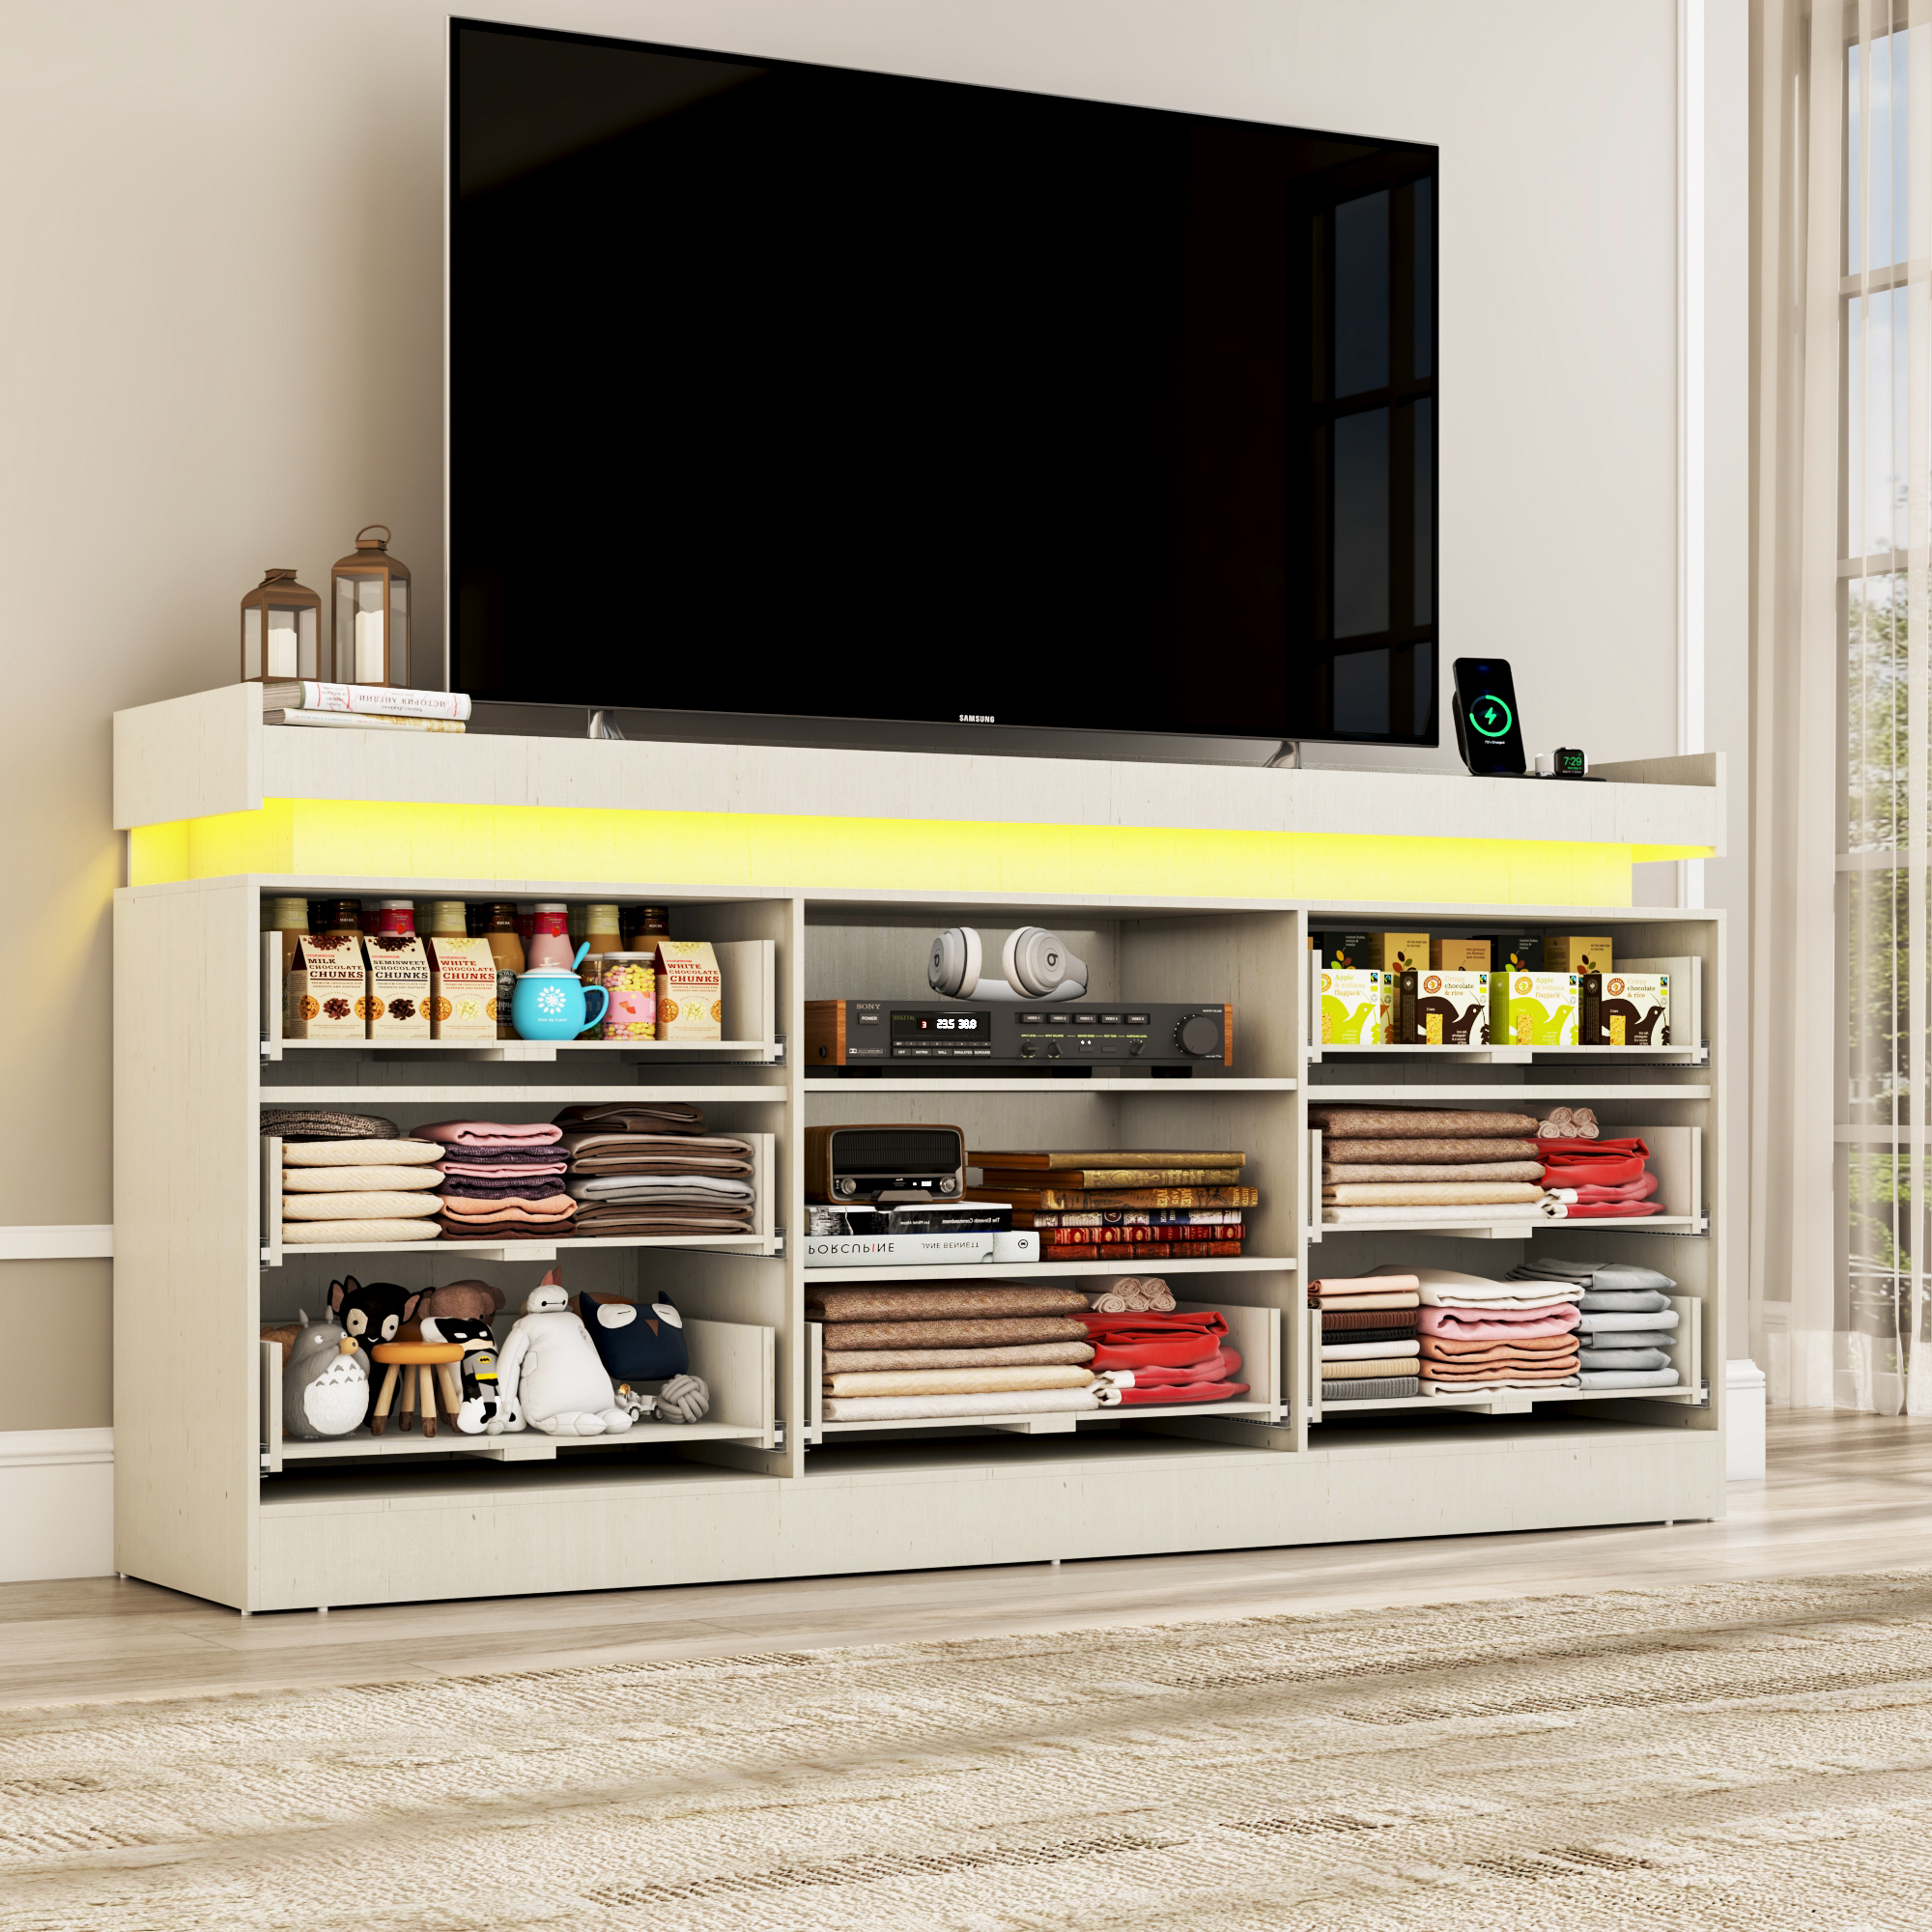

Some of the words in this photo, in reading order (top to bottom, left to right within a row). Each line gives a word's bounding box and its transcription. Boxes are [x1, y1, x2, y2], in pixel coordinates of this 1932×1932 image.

[402, 697, 445, 708] ИСТОРИЯ
[959, 714, 995, 723] SAMSUNG
[1564, 757, 1581, 766] 7:29
